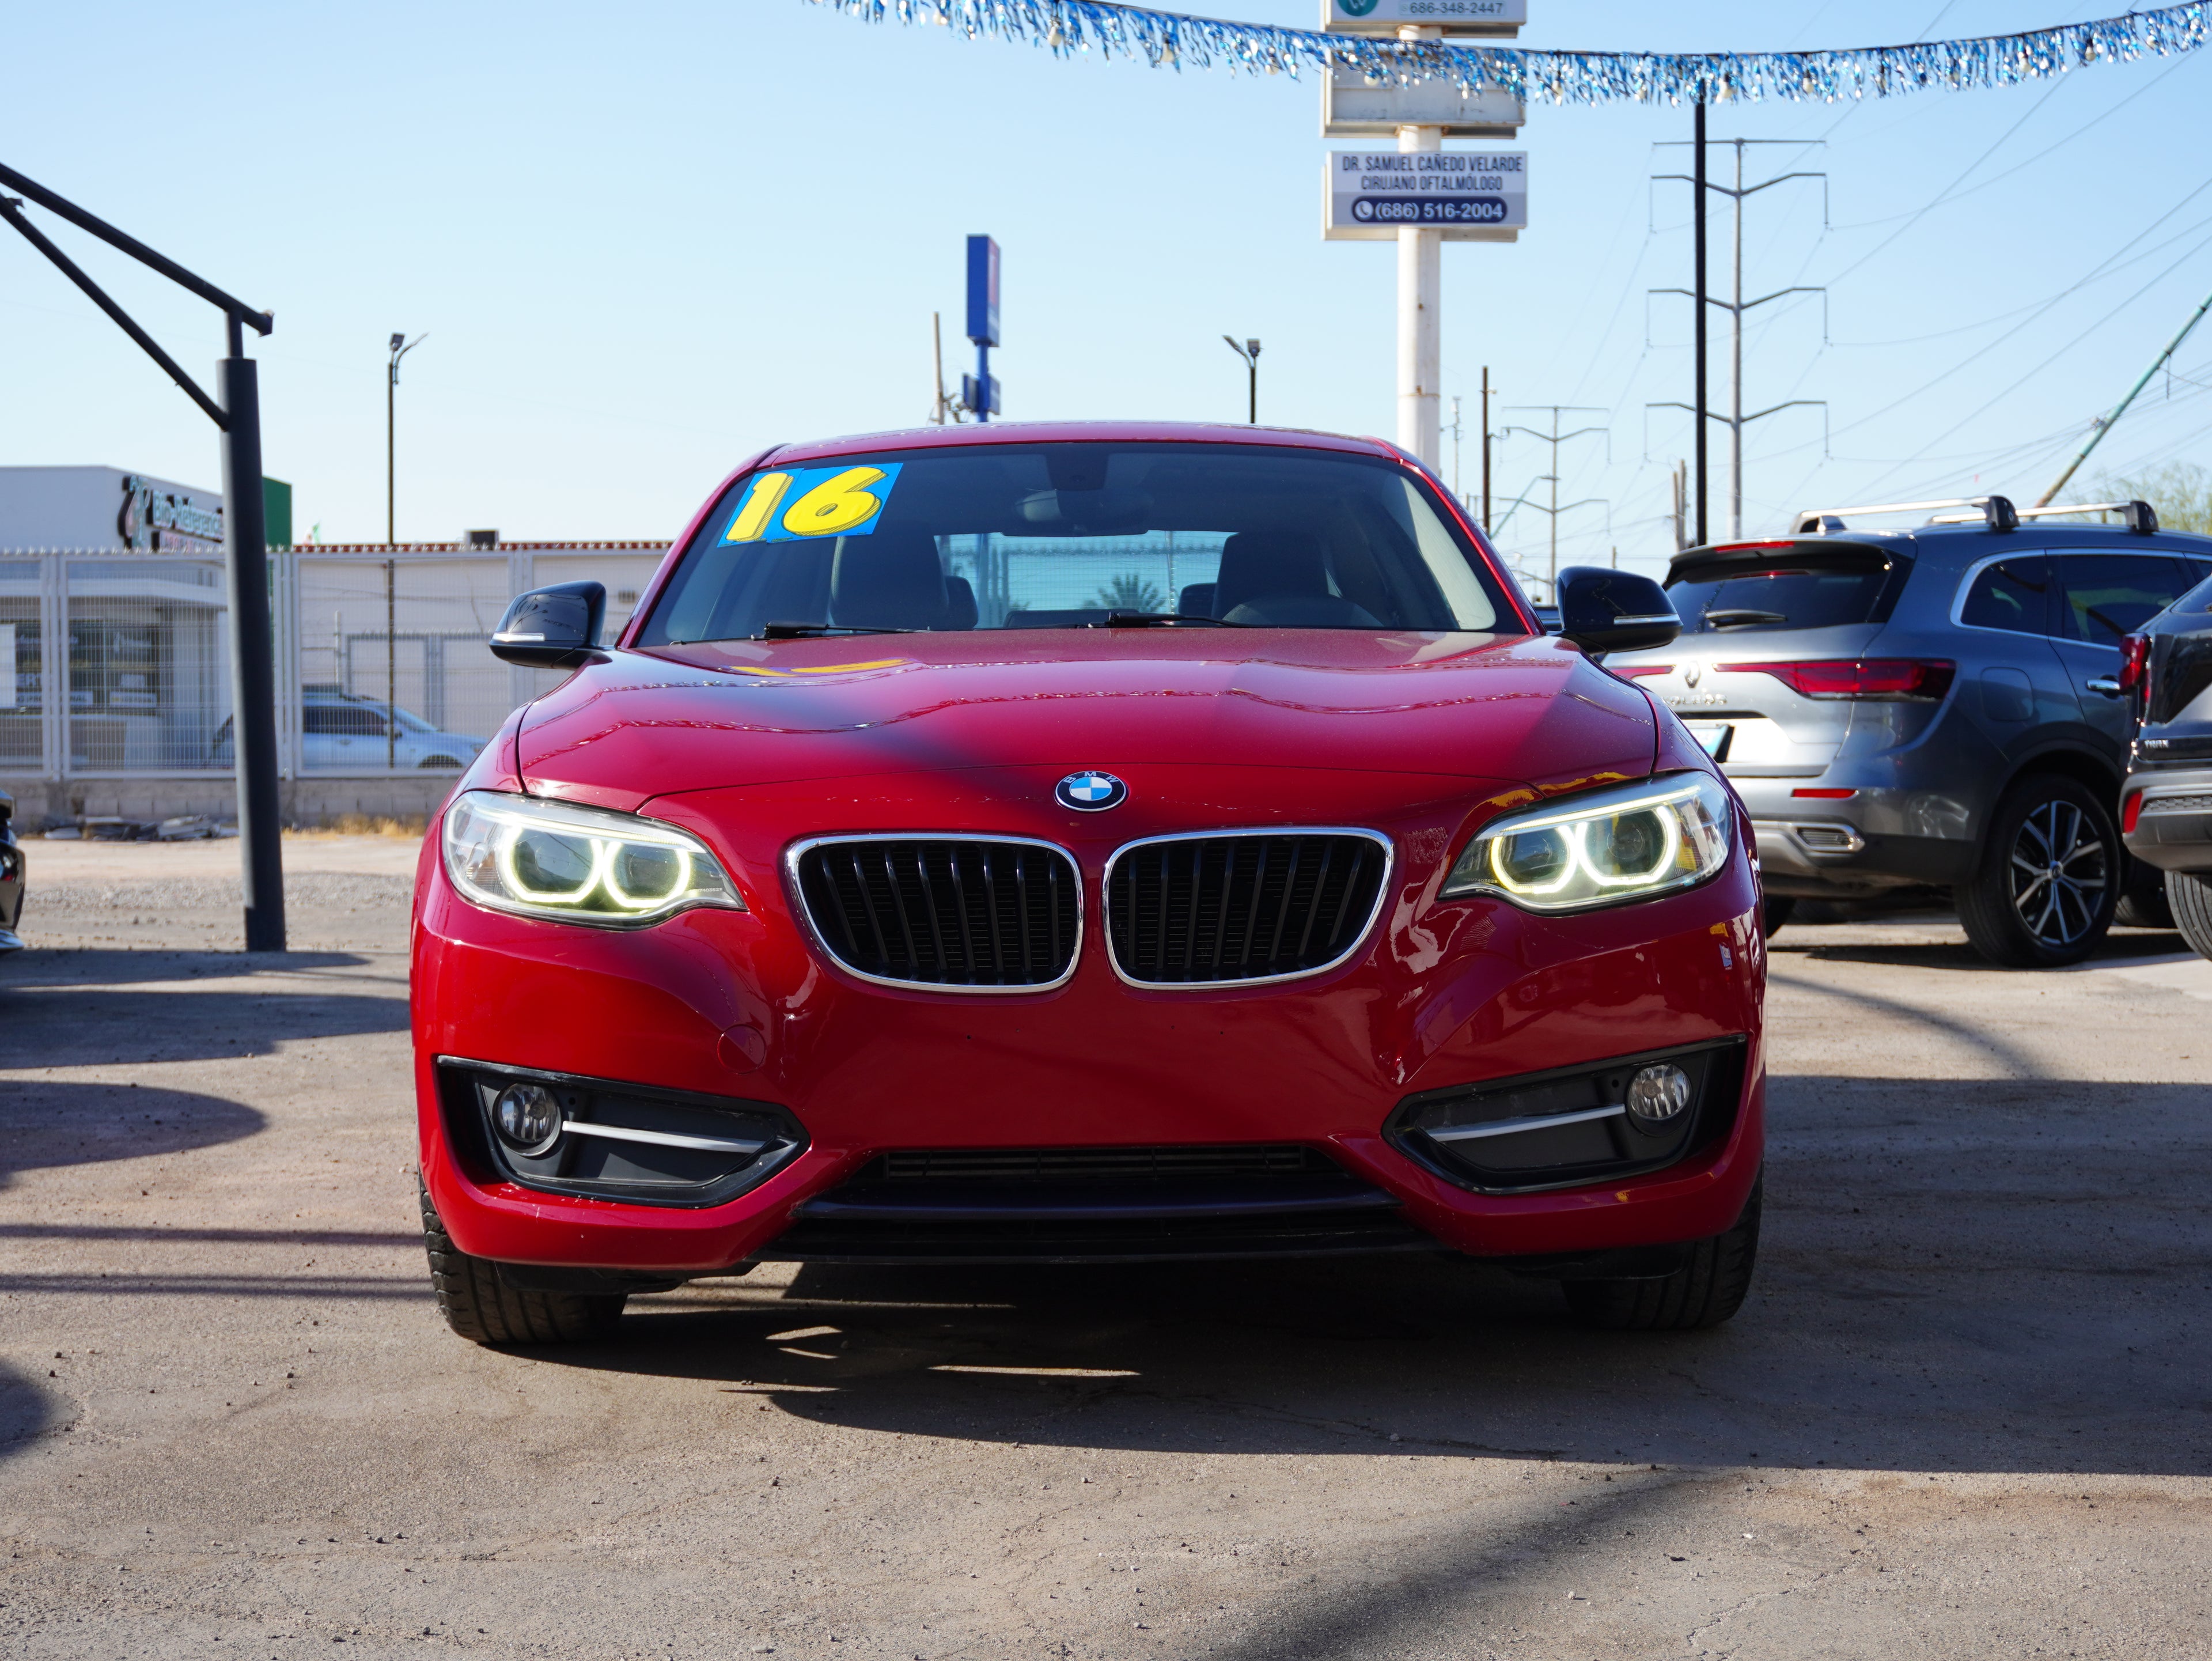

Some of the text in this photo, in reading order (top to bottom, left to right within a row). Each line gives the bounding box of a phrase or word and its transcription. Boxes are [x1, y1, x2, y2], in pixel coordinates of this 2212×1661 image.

[1410, 2, 1504, 14] 686-348-2447
[1342, 153, 1522, 172] DR. SAMUEL CAÑEDO VELARDE
[1361, 172, 1503, 191] CIRUJANO OFTALMÓLOGO
[1375, 202, 1503, 221] (686) 516-2004
[725, 466, 888, 542] 16
[1063, 771, 1119, 784] BMW
